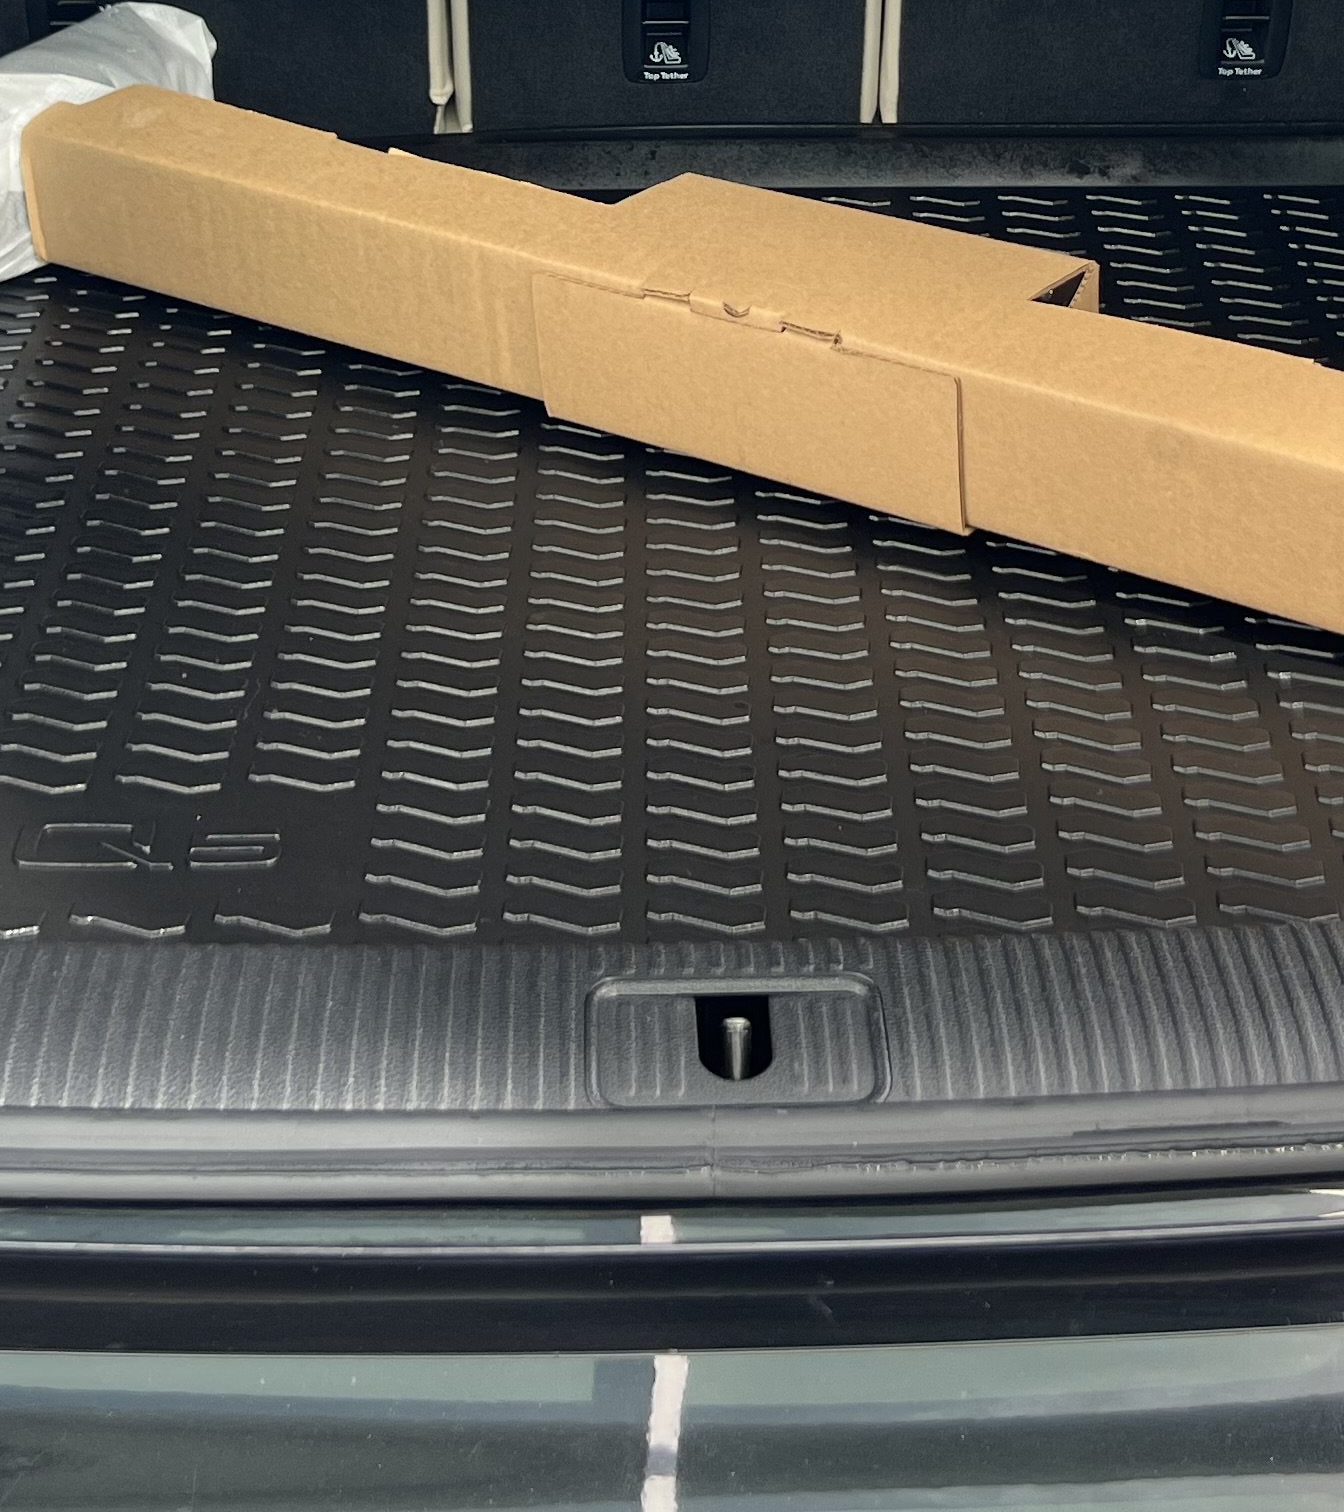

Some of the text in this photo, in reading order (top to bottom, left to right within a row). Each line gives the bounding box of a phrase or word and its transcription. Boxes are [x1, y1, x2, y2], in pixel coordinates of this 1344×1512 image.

[643, 71, 689, 81] Top Tether
[1217, 67, 1263, 76] Top Tether
[13, 816, 281, 871] Q5
